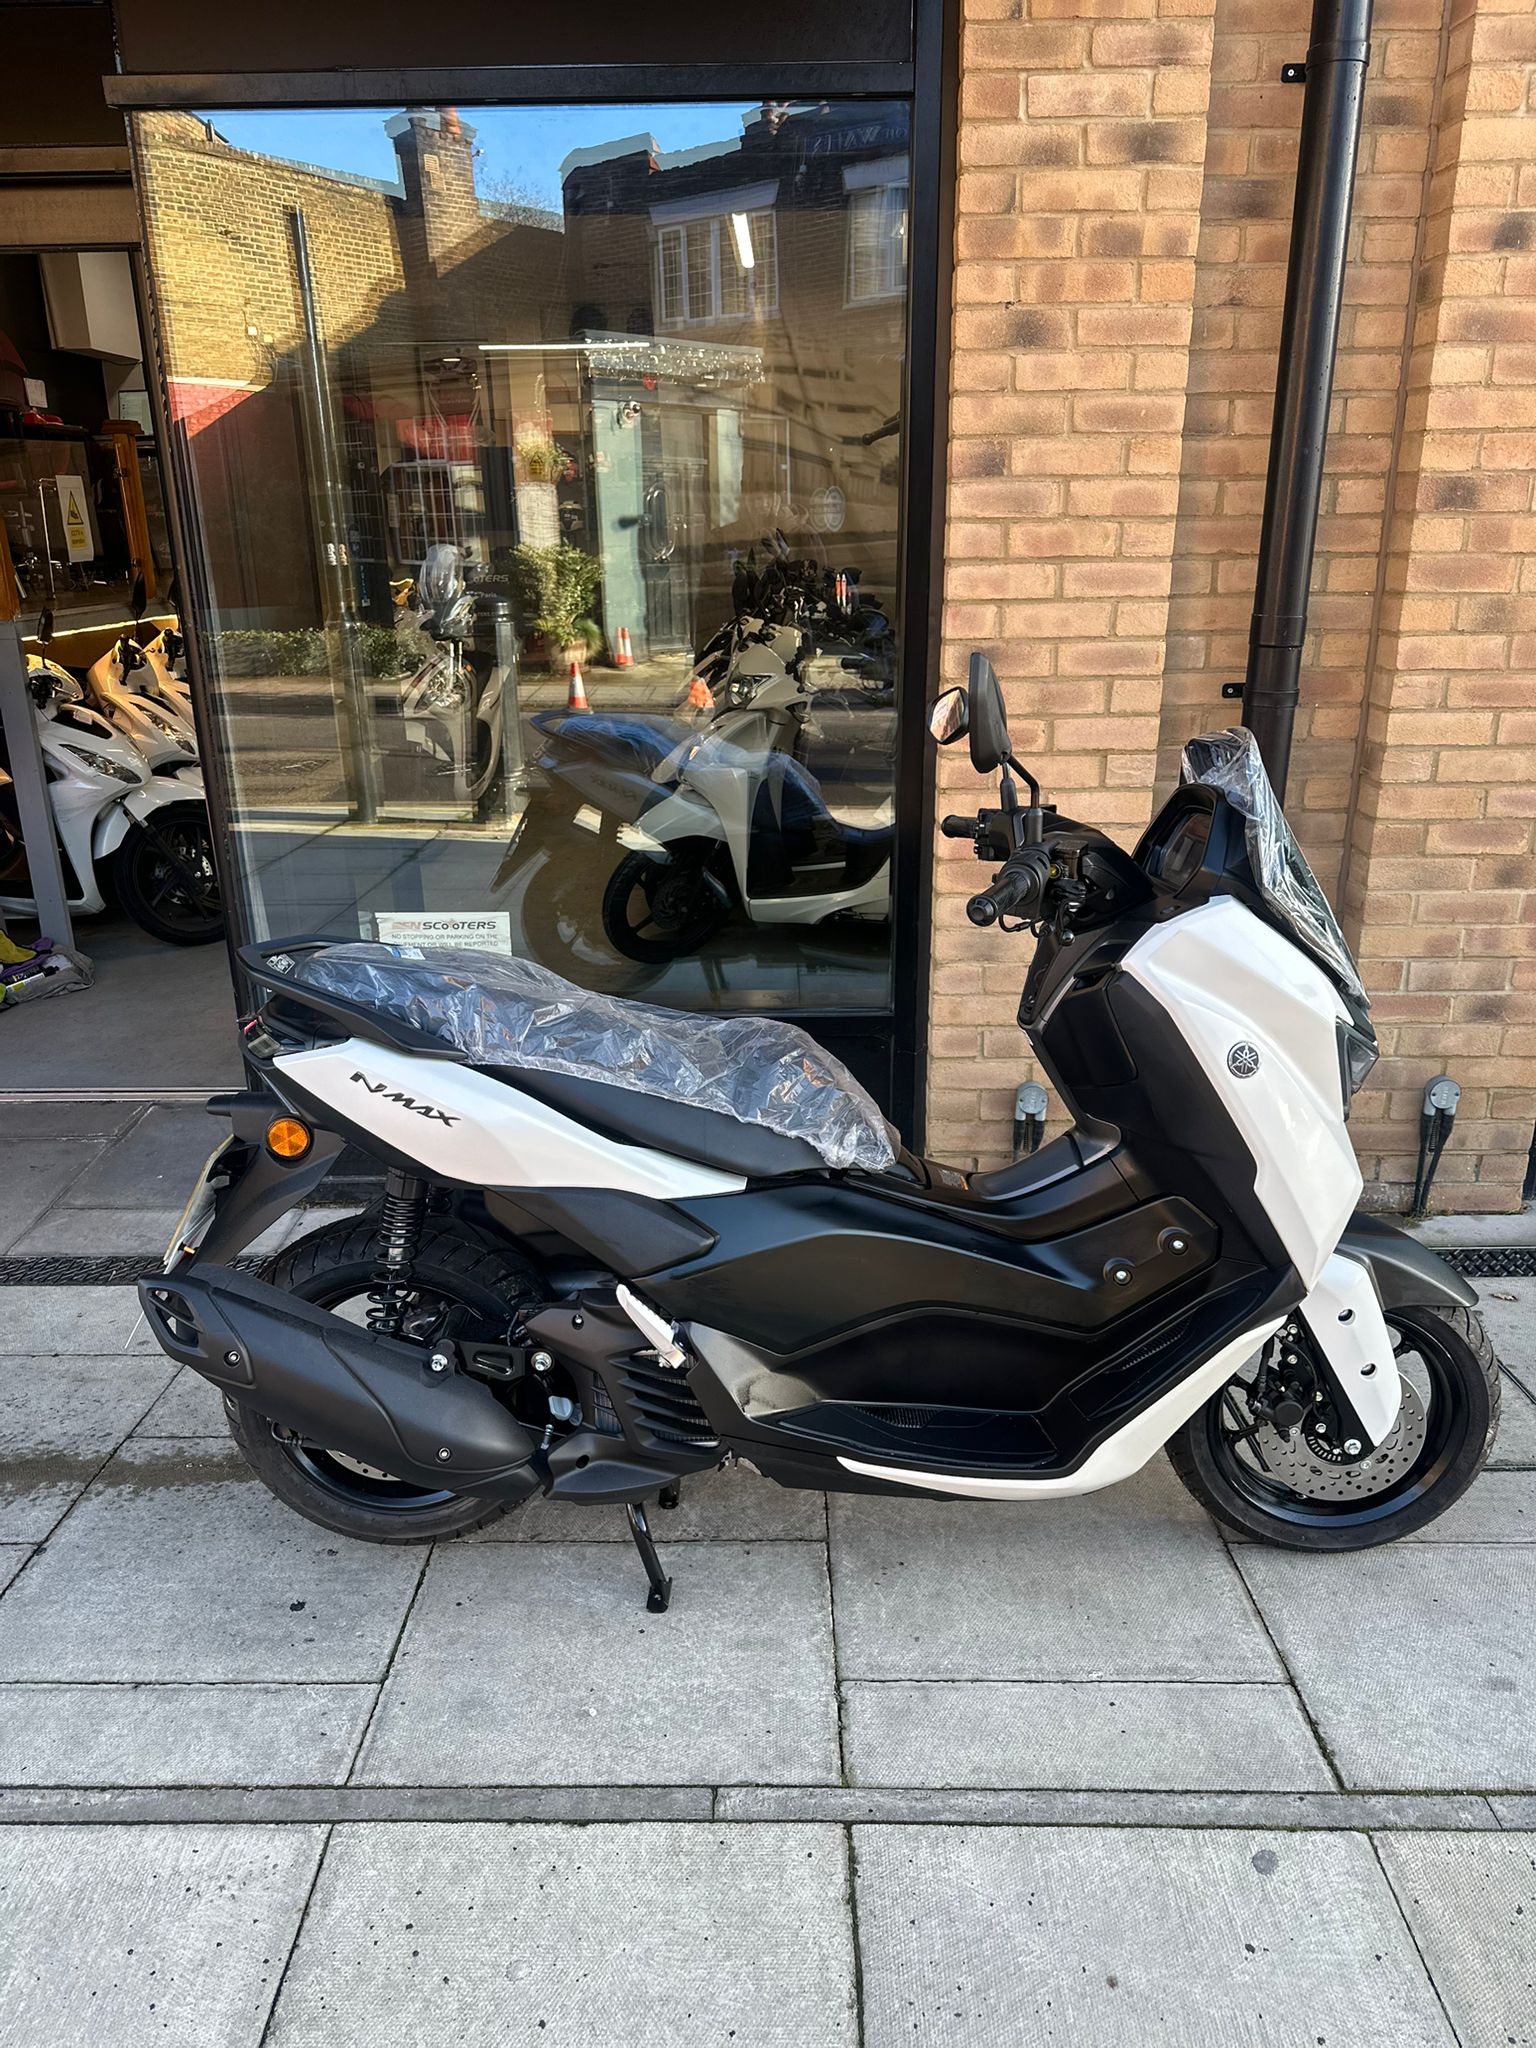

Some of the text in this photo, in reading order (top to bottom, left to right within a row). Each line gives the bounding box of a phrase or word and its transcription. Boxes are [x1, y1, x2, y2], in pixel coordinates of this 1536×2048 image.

[402, 933, 434, 941] STOPPING
[434, 933, 445, 941] OR
[454, 941, 463, 949] BE
[463, 940, 499, 948] REPORTED
[349, 1070, 462, 1128] NMAX
